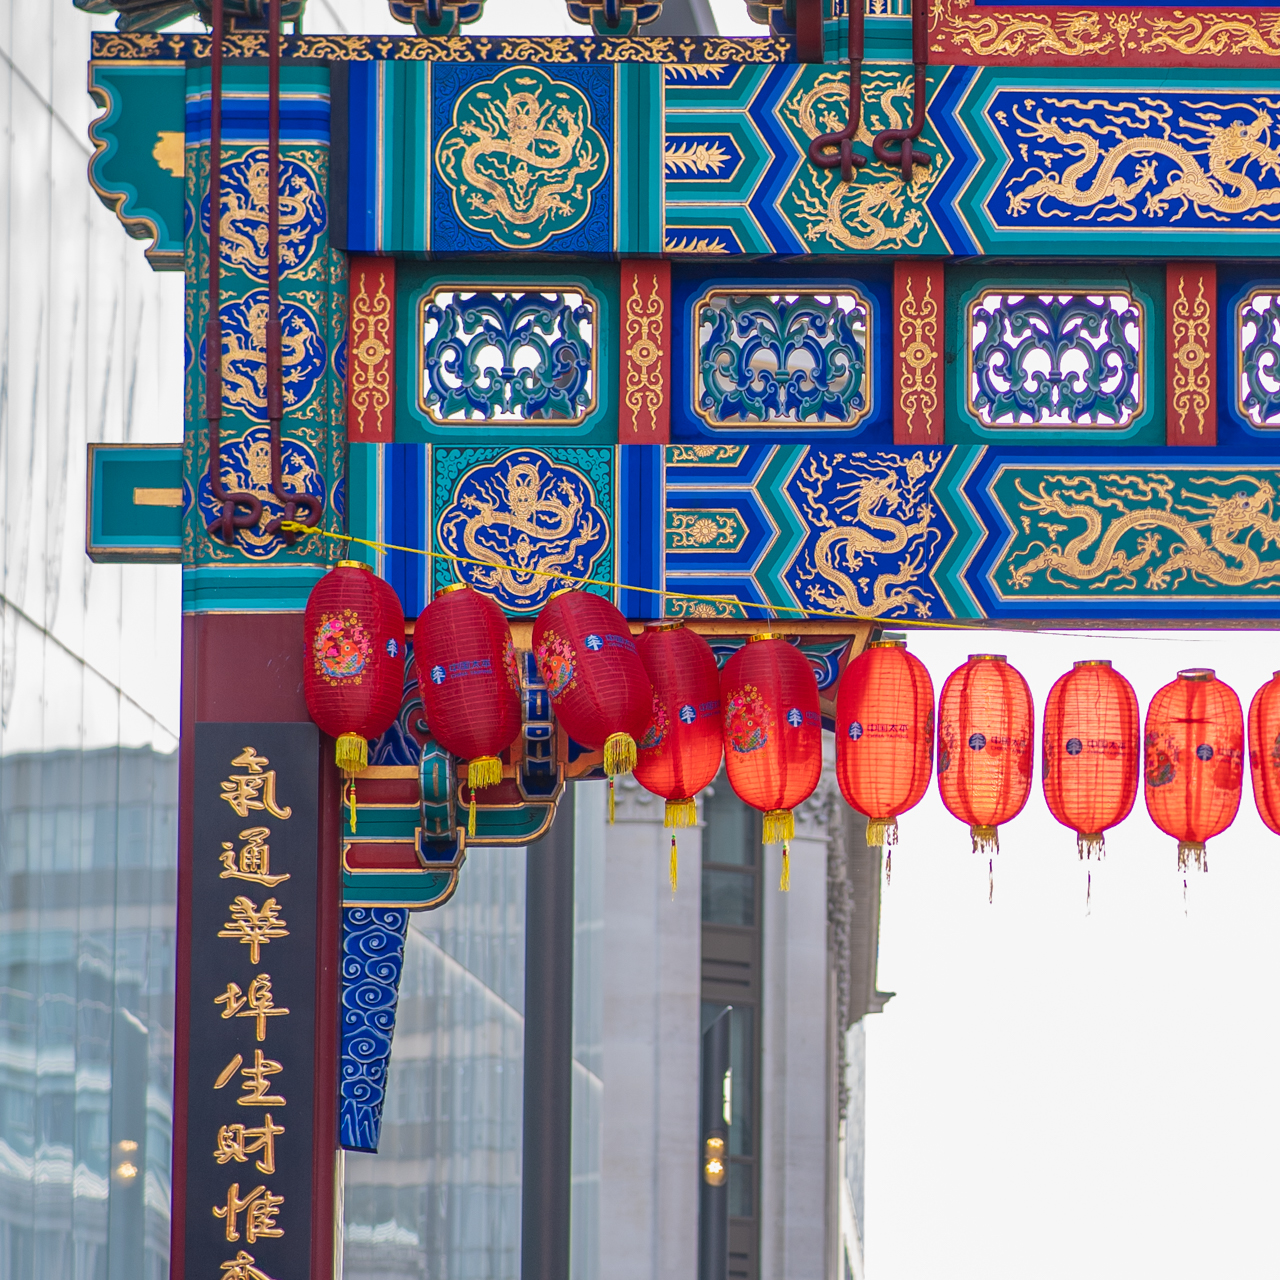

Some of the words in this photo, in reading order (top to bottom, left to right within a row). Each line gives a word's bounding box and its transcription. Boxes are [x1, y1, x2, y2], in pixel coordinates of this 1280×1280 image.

[448, 659, 491, 672] 中国太平
[867, 723, 909, 733] 中国太平
